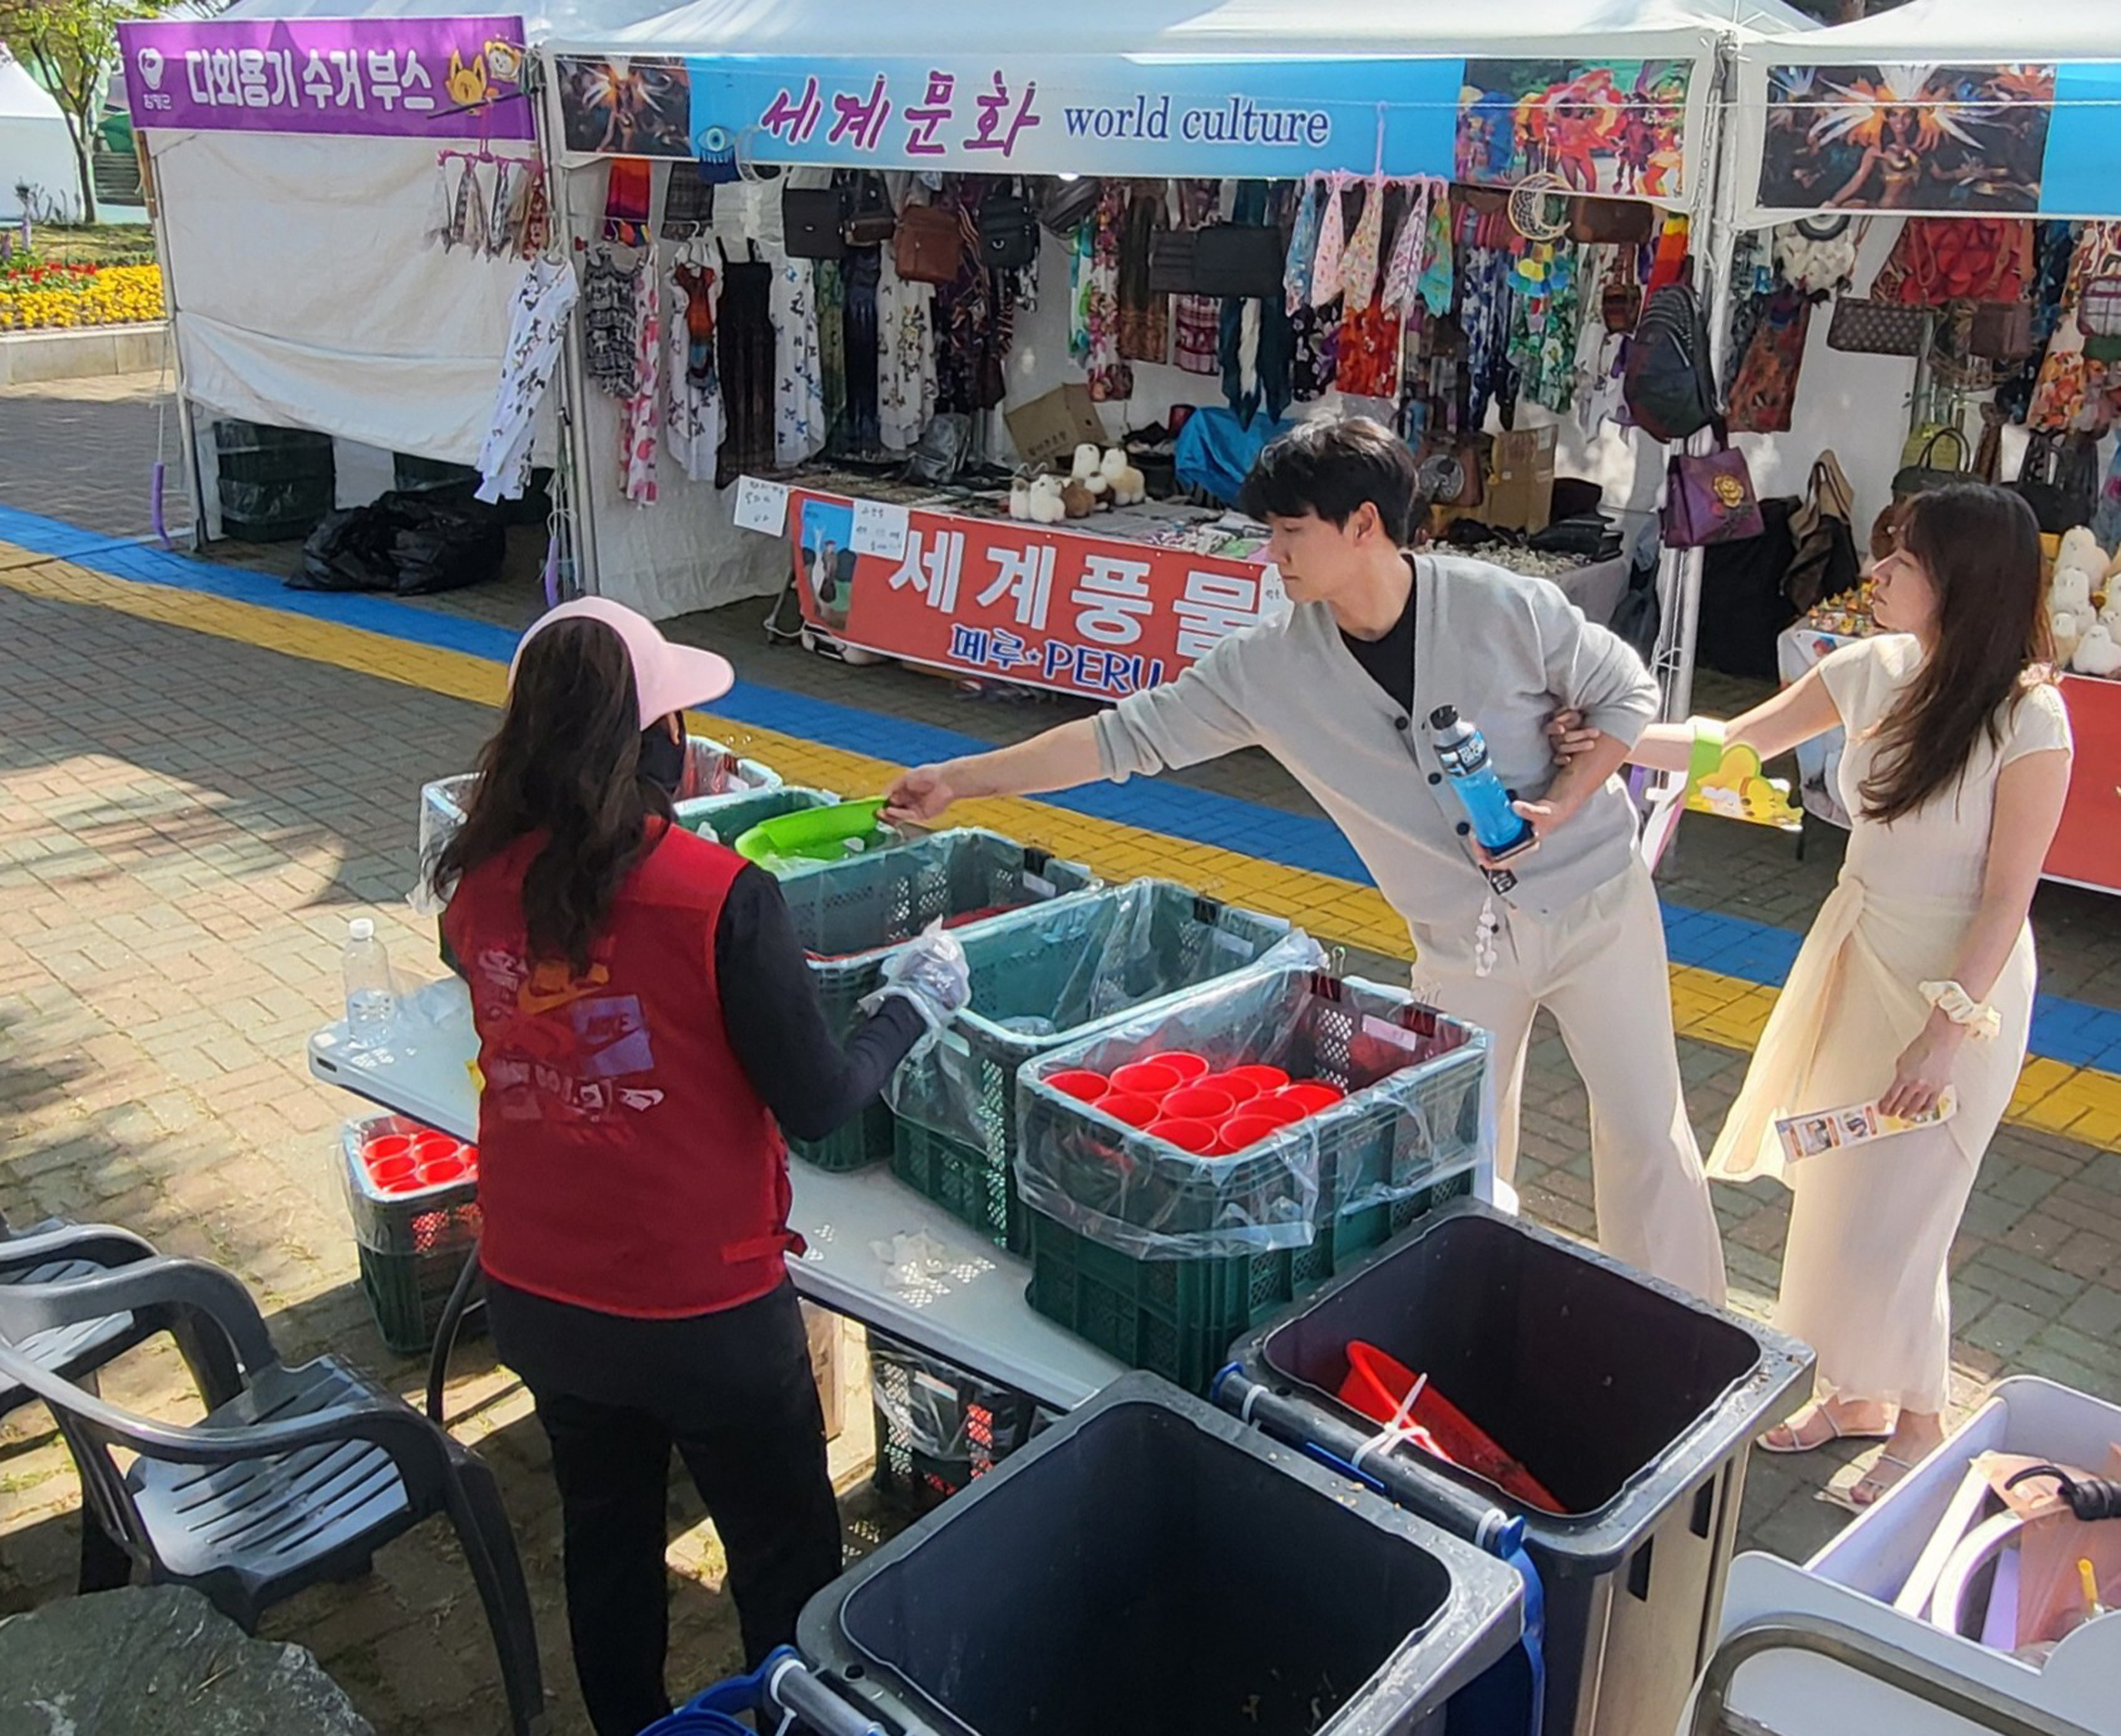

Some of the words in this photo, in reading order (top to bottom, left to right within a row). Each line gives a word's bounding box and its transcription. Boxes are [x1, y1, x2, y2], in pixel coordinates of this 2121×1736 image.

[185, 48, 299, 108] 다회용기
[303, 48, 365, 110] 수거
[368, 49, 435, 111] 부스
[1064, 95, 1170, 139] world
[1182, 96, 1329, 145] culture
